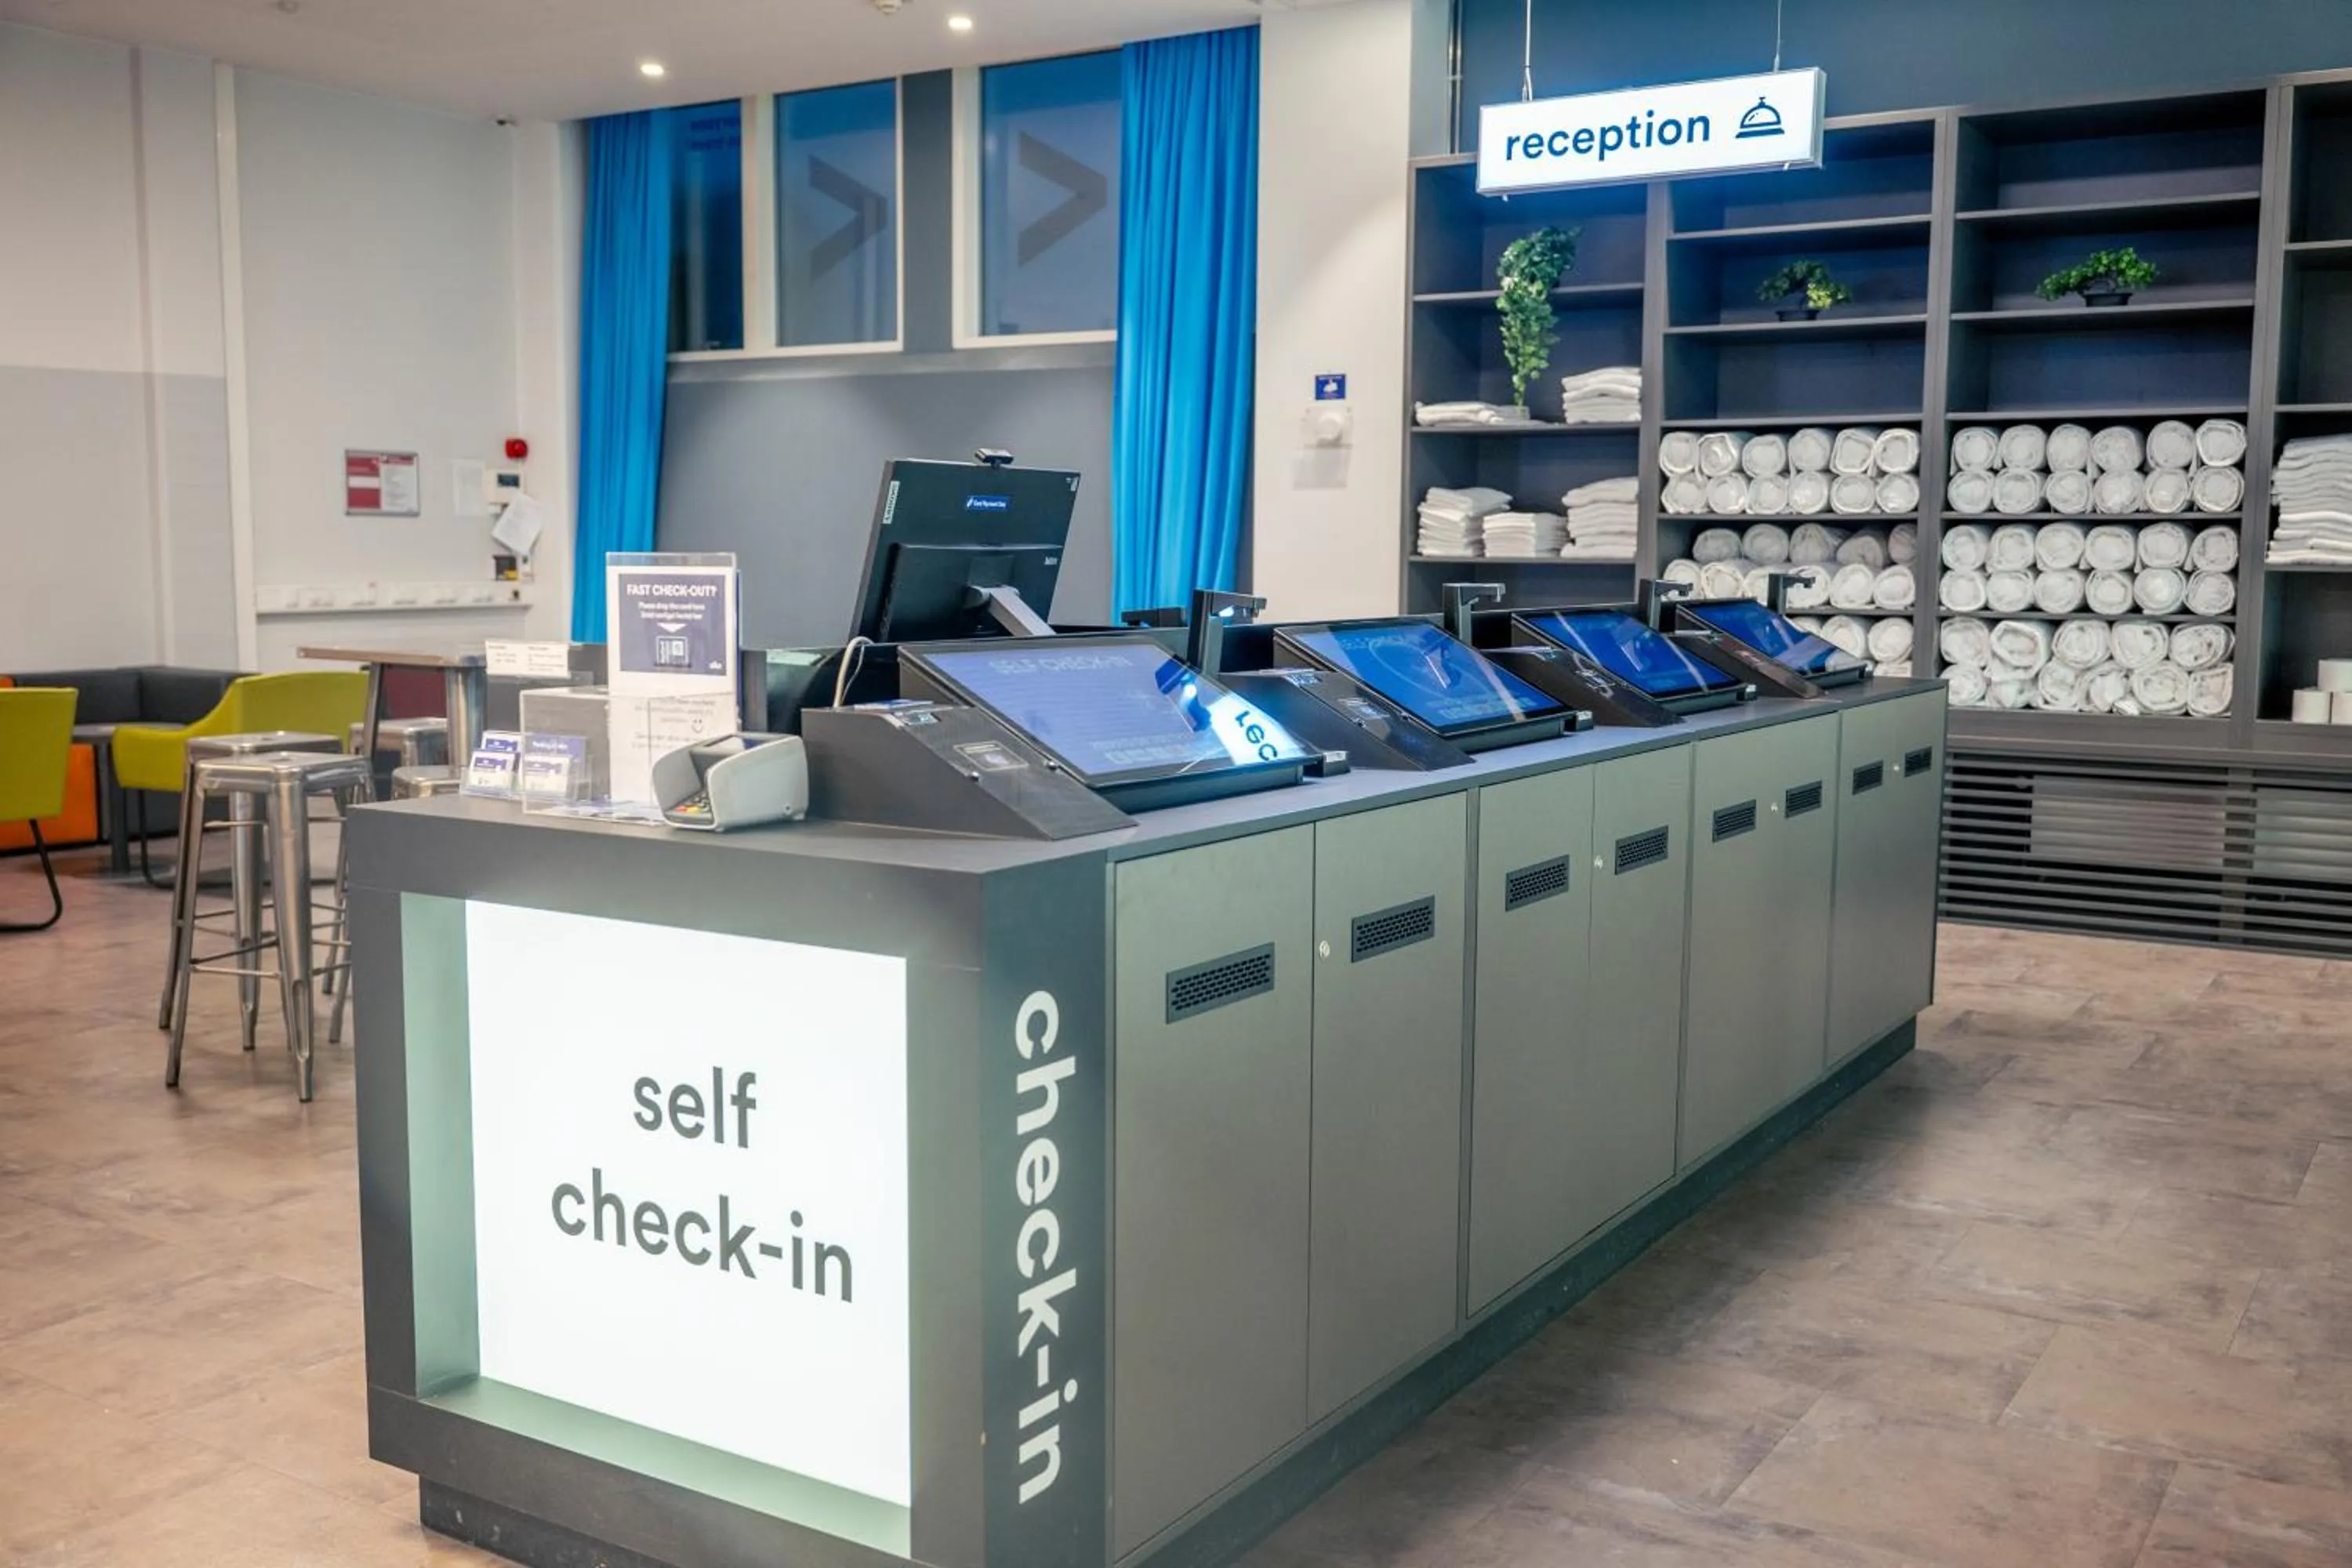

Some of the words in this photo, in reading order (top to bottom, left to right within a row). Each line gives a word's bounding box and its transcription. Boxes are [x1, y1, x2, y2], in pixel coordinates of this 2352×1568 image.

[1505, 109, 1711, 162] reception
[626, 584, 651, 596] FAST
[652, 585, 717, 597] CHECK-OUT?
[633, 1065, 757, 1149] self
[551, 1167, 853, 1303] check-in
[1014, 990, 1078, 1504] check-in
